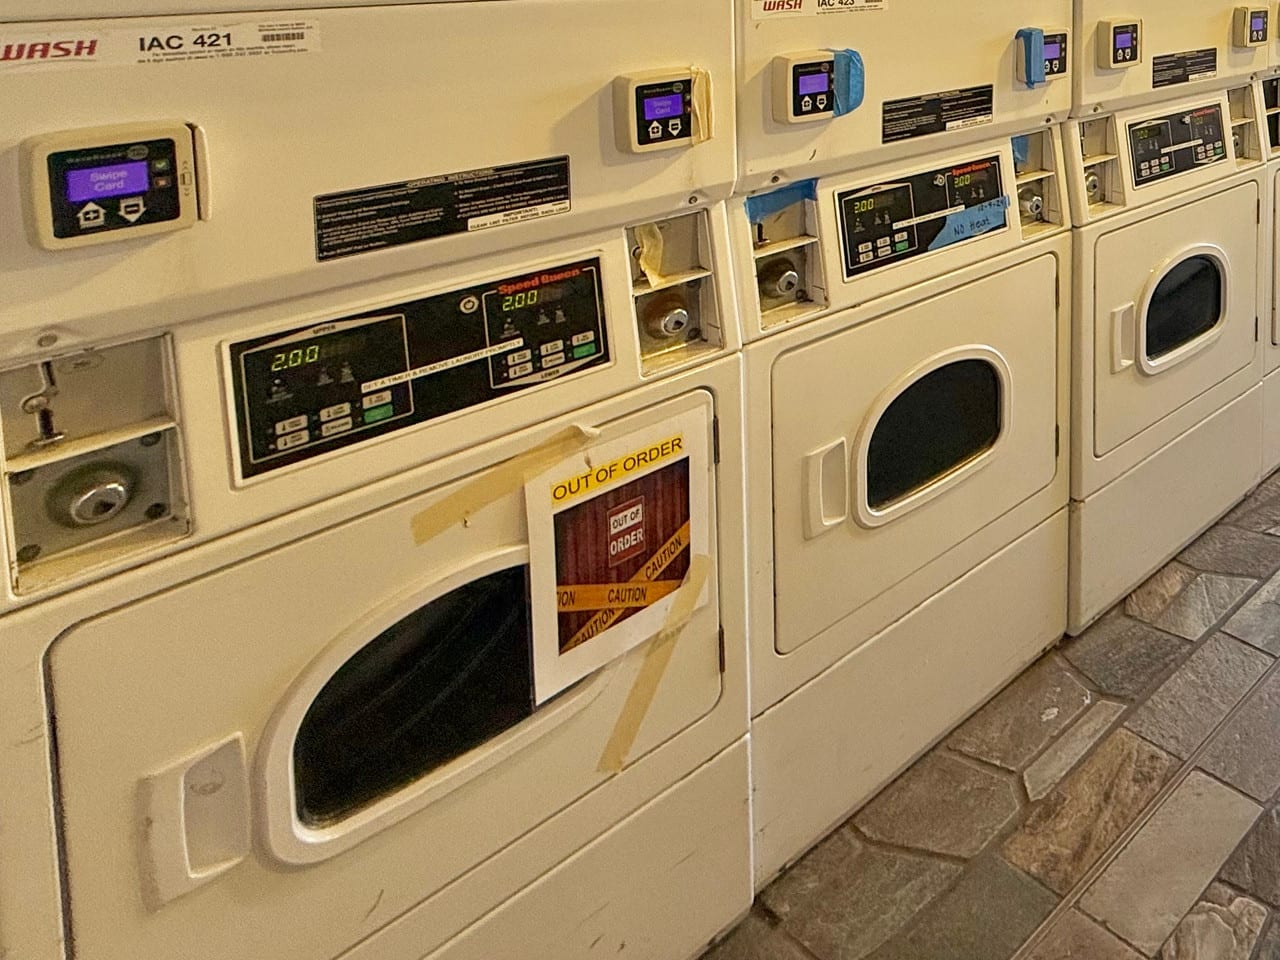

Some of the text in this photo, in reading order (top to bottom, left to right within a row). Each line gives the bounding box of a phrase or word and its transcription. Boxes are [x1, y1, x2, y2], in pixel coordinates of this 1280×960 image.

[763, 0, 803, 11] WASH
[139, 35, 184, 51] IAC
[193, 33, 232, 47] 421
[90, 170, 128, 182] Swipe
[94, 180, 124, 192] Card
[498, 269, 580, 294] Speed Queen
[502, 290, 538, 312] 2.00
[313, 324, 336, 334] UPPER
[271, 345, 319, 371] 2.00
[387, 373, 411, 383] TIMER
[419, 362, 449, 374] REMOVE
[451, 352, 484, 364] LAUNDRY
[541, 369, 560, 379] LOWER
[553, 437, 683, 501] OUT OF ORDER
[612, 508, 640, 530] OUT OF
[610, 528, 644, 556] ORDER
[645, 536, 682, 580] CAUTION
[557, 586, 648, 607] ION CAUTION
